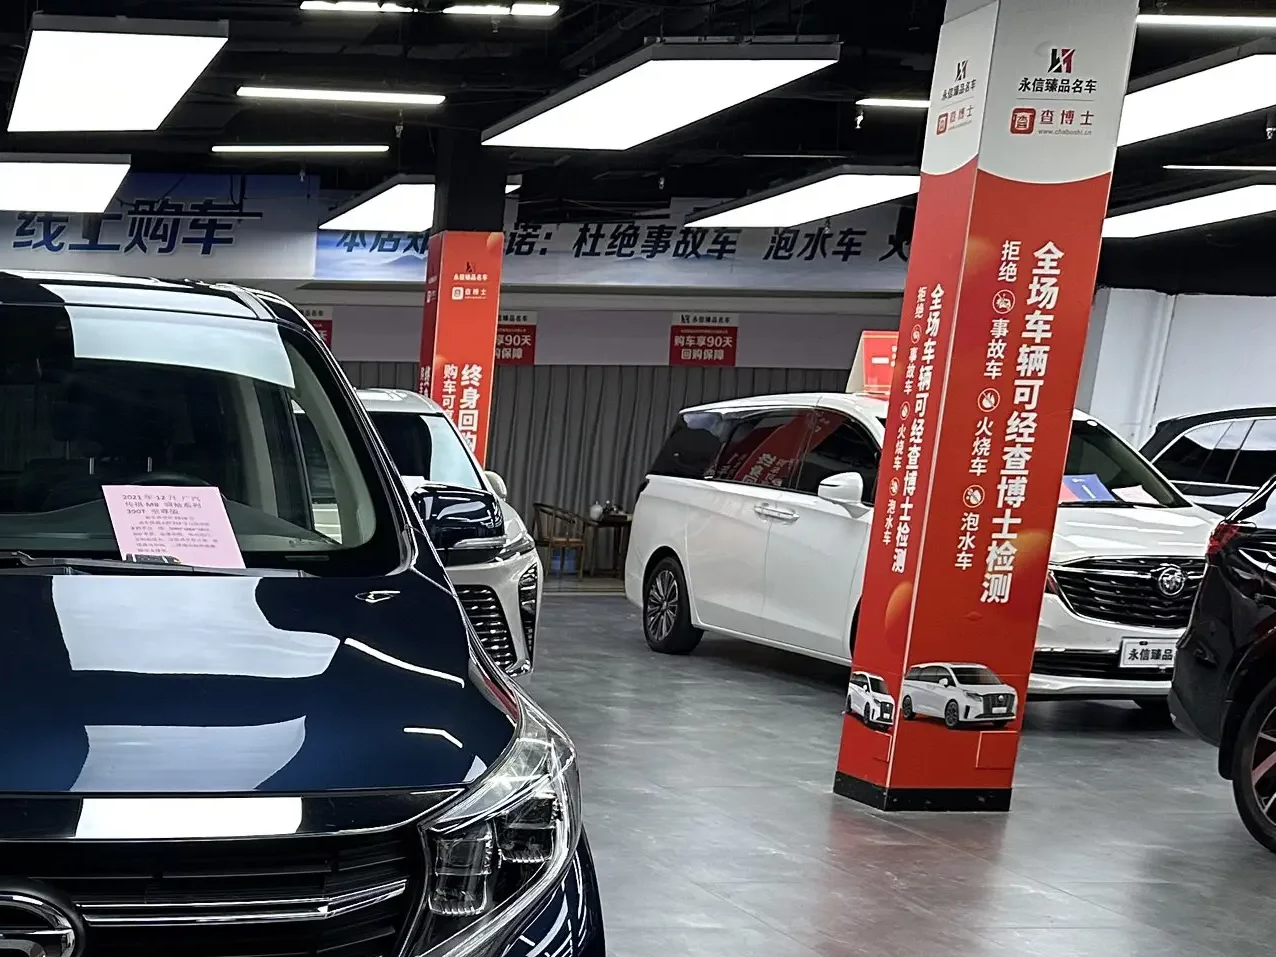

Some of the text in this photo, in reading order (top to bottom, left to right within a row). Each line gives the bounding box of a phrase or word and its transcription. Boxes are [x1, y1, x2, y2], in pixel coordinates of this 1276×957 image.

[1017, 78, 1098, 94] 永信臻品名车
[1039, 109, 1095, 126] 查博士
[12, 199, 235, 256] 线上购车
[673, 335, 733, 348] 购车享90天
[891, 283, 945, 574] 全场车辆可经查博士检测
[954, 240, 1022, 570] 拒绝 事故车 火烧车 泡水车
[979, 240, 1065, 604] 全场车辆可经查博士检测
